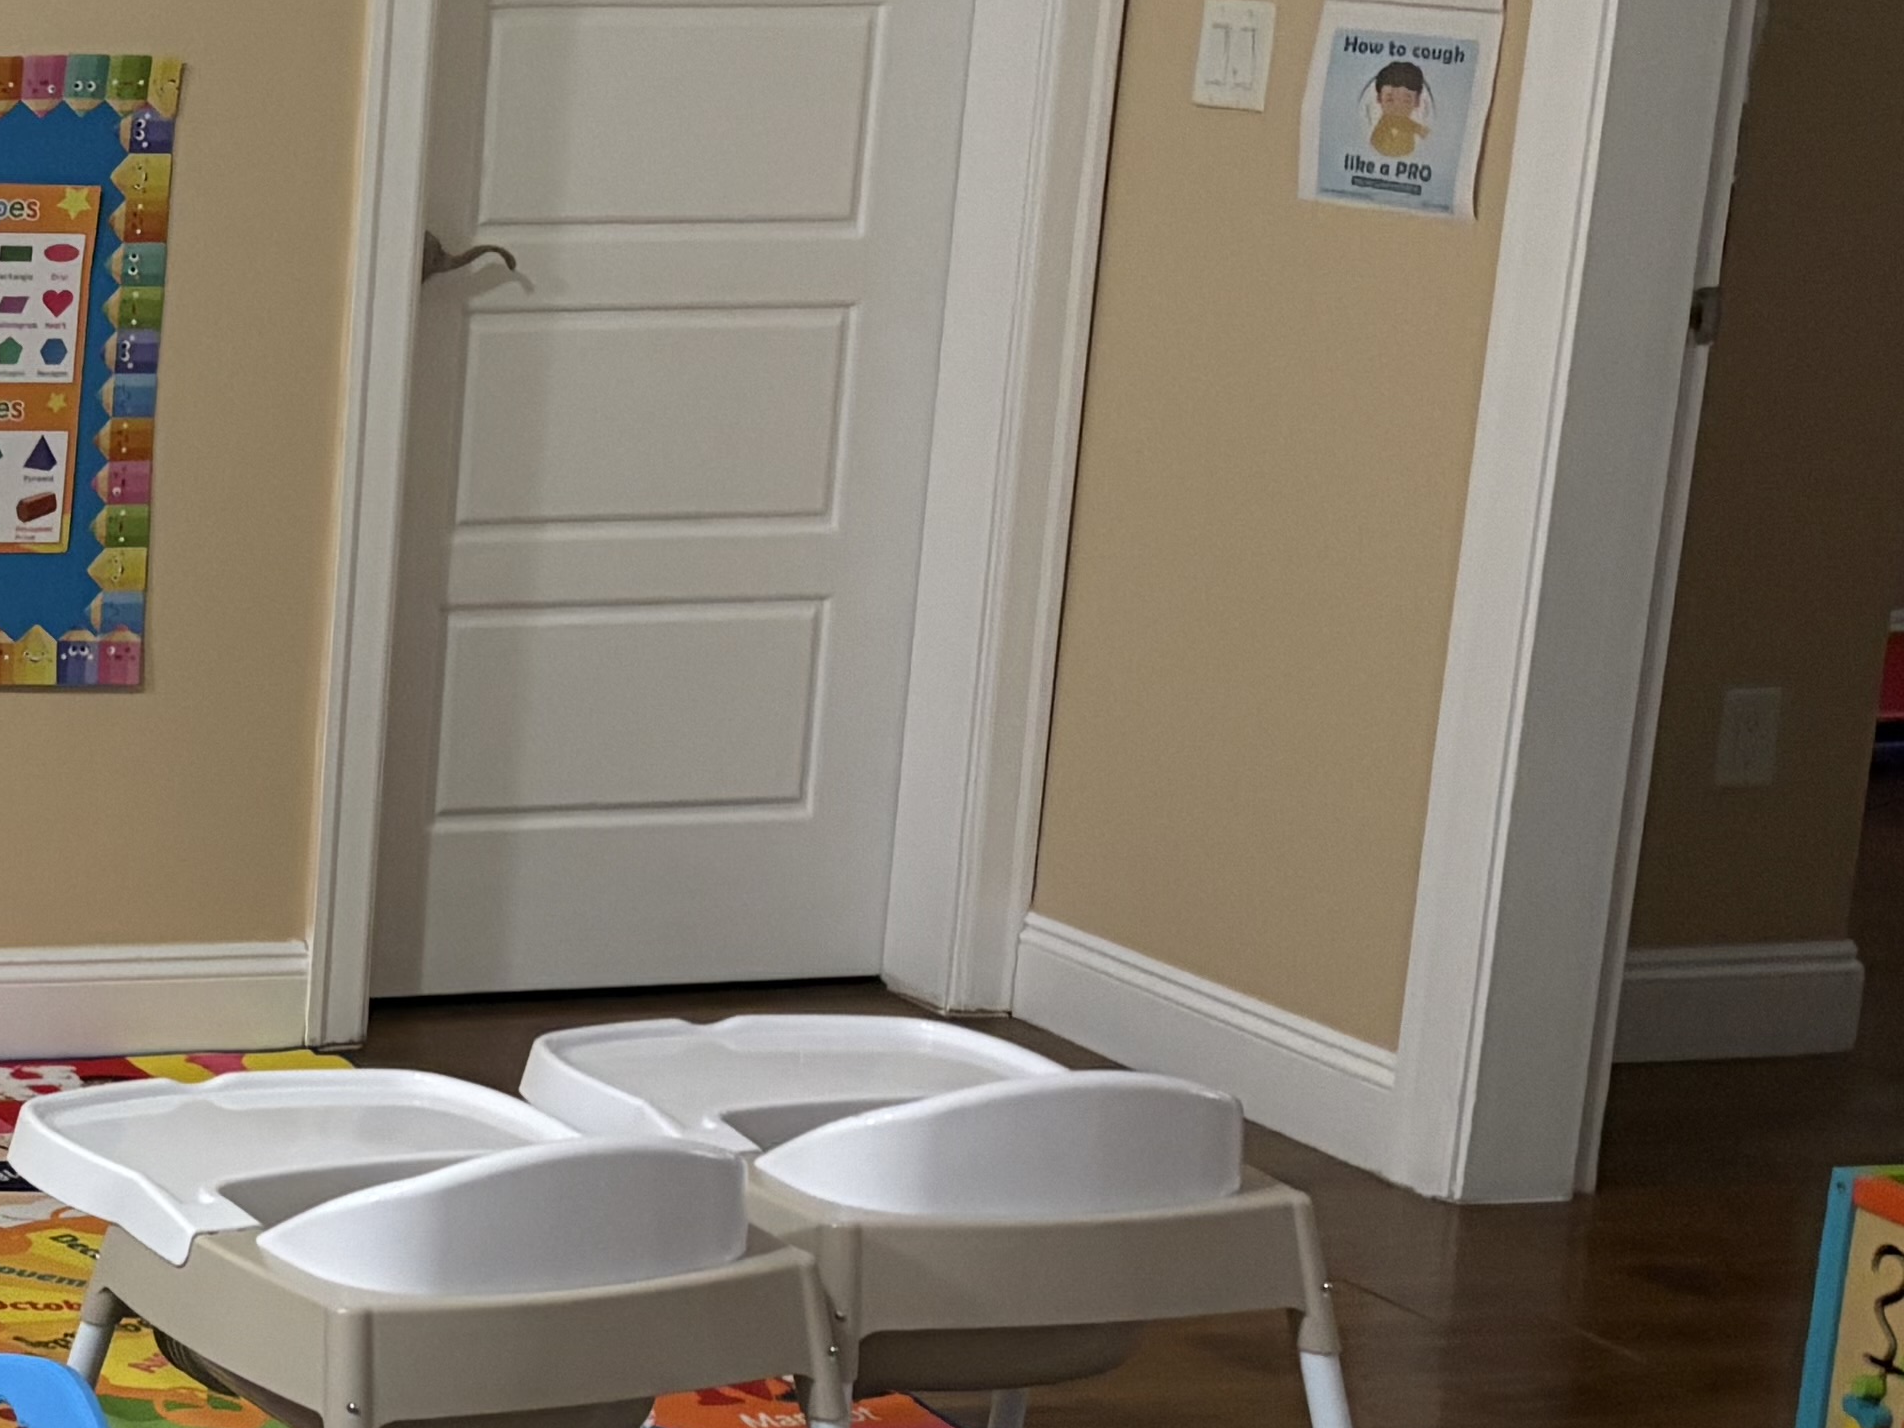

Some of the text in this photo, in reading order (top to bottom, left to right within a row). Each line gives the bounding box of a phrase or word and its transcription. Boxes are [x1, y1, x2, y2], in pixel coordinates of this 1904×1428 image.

[1343, 35, 1465, 64] How to cough
[1344, 154, 1432, 182] like a PRO
